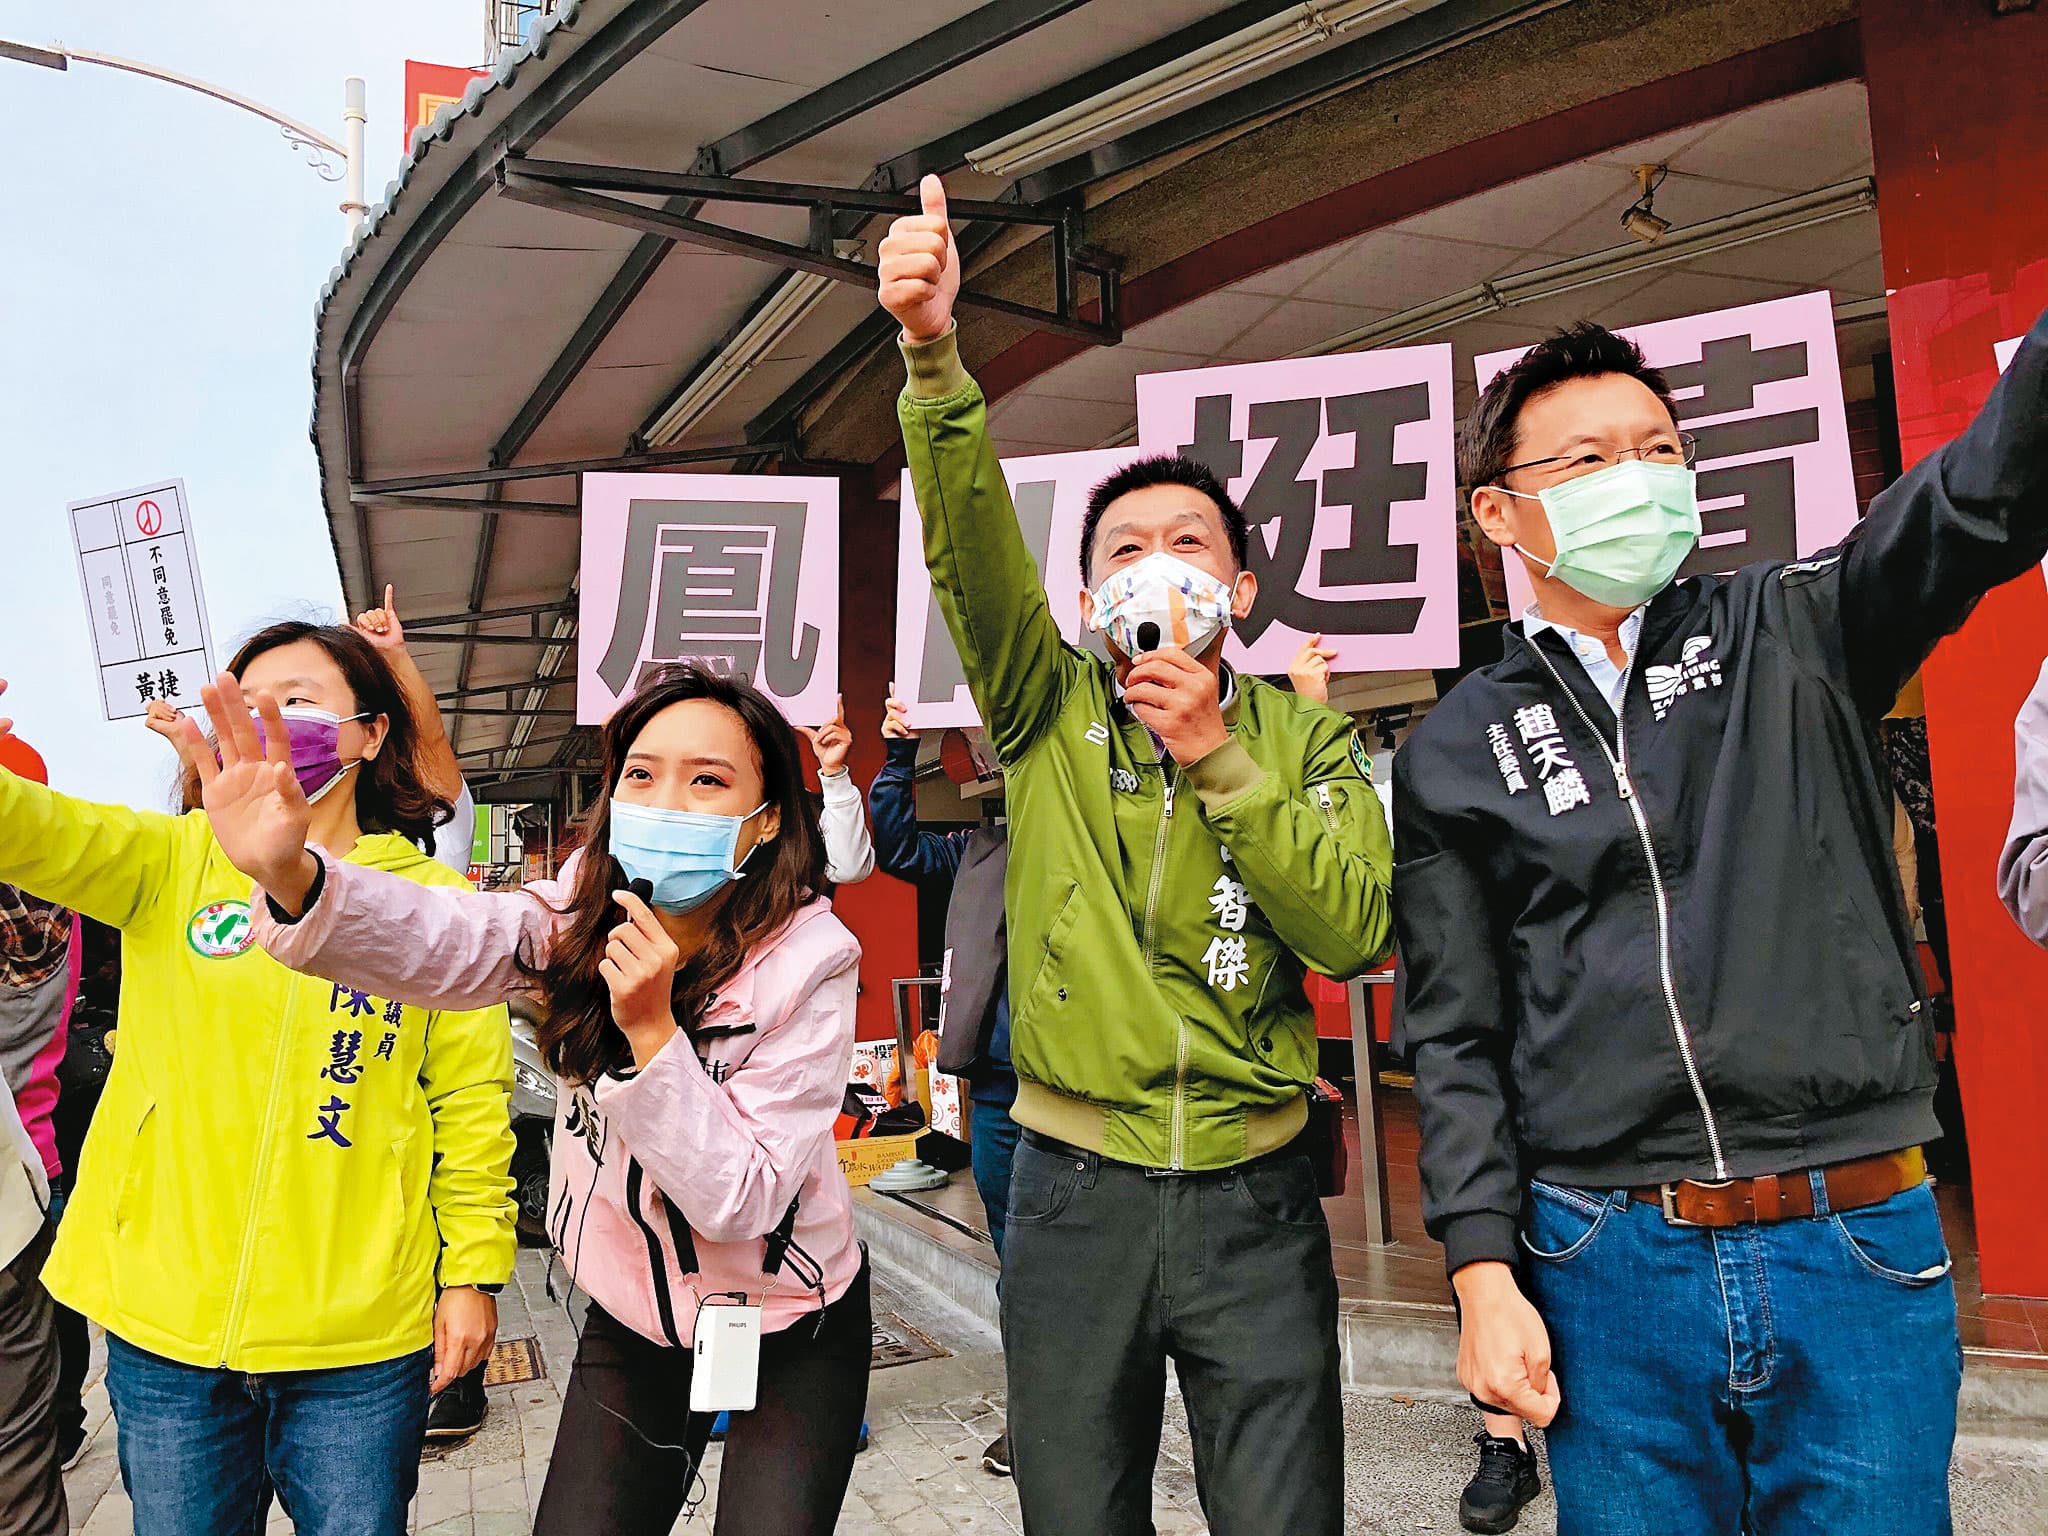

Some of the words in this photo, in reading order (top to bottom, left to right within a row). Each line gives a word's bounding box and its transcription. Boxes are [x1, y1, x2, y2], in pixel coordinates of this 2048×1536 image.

[1177, 381, 1431, 649] 挺
[101, 575, 121, 637] 同意罷免
[149, 545, 178, 647] 不同意罷免
[596, 498, 820, 699] 鳳
[135, 668, 182, 704] 黃捷
[1485, 723, 1530, 796] 主任委員
[1512, 703, 1590, 817] 趙天麟
[1200, 845, 1252, 993] 智傑
